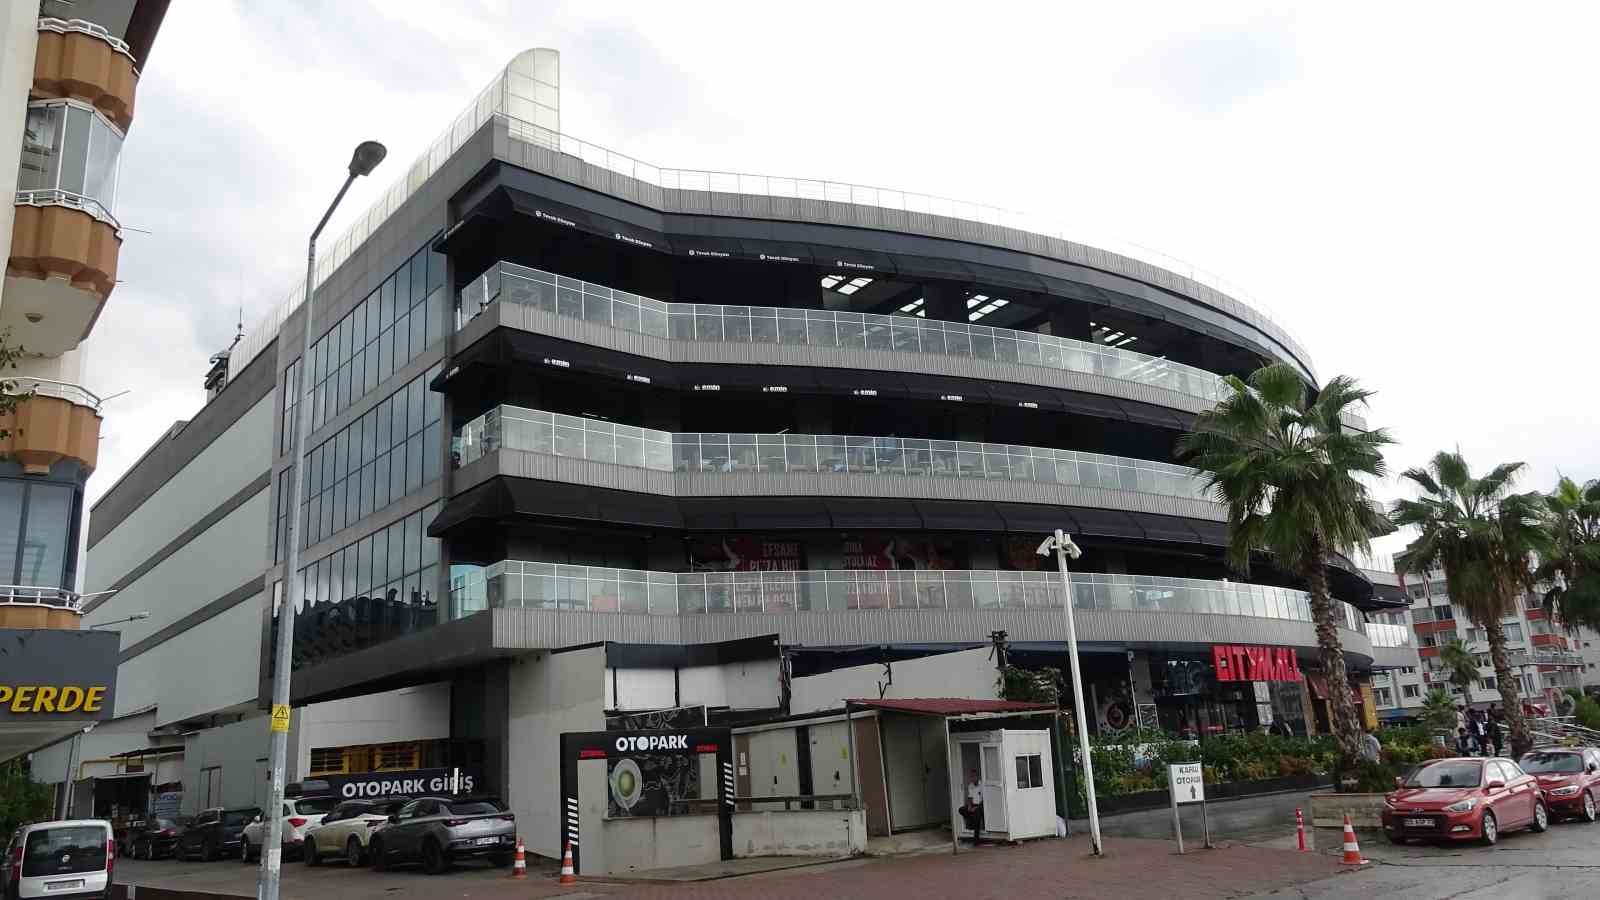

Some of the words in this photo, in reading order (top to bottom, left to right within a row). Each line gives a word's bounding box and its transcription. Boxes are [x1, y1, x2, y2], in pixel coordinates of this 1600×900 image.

[0, 686, 107, 712] PERDE
[615, 735, 688, 751] OTOPARK
[342, 778, 425, 798] OTOPARK
